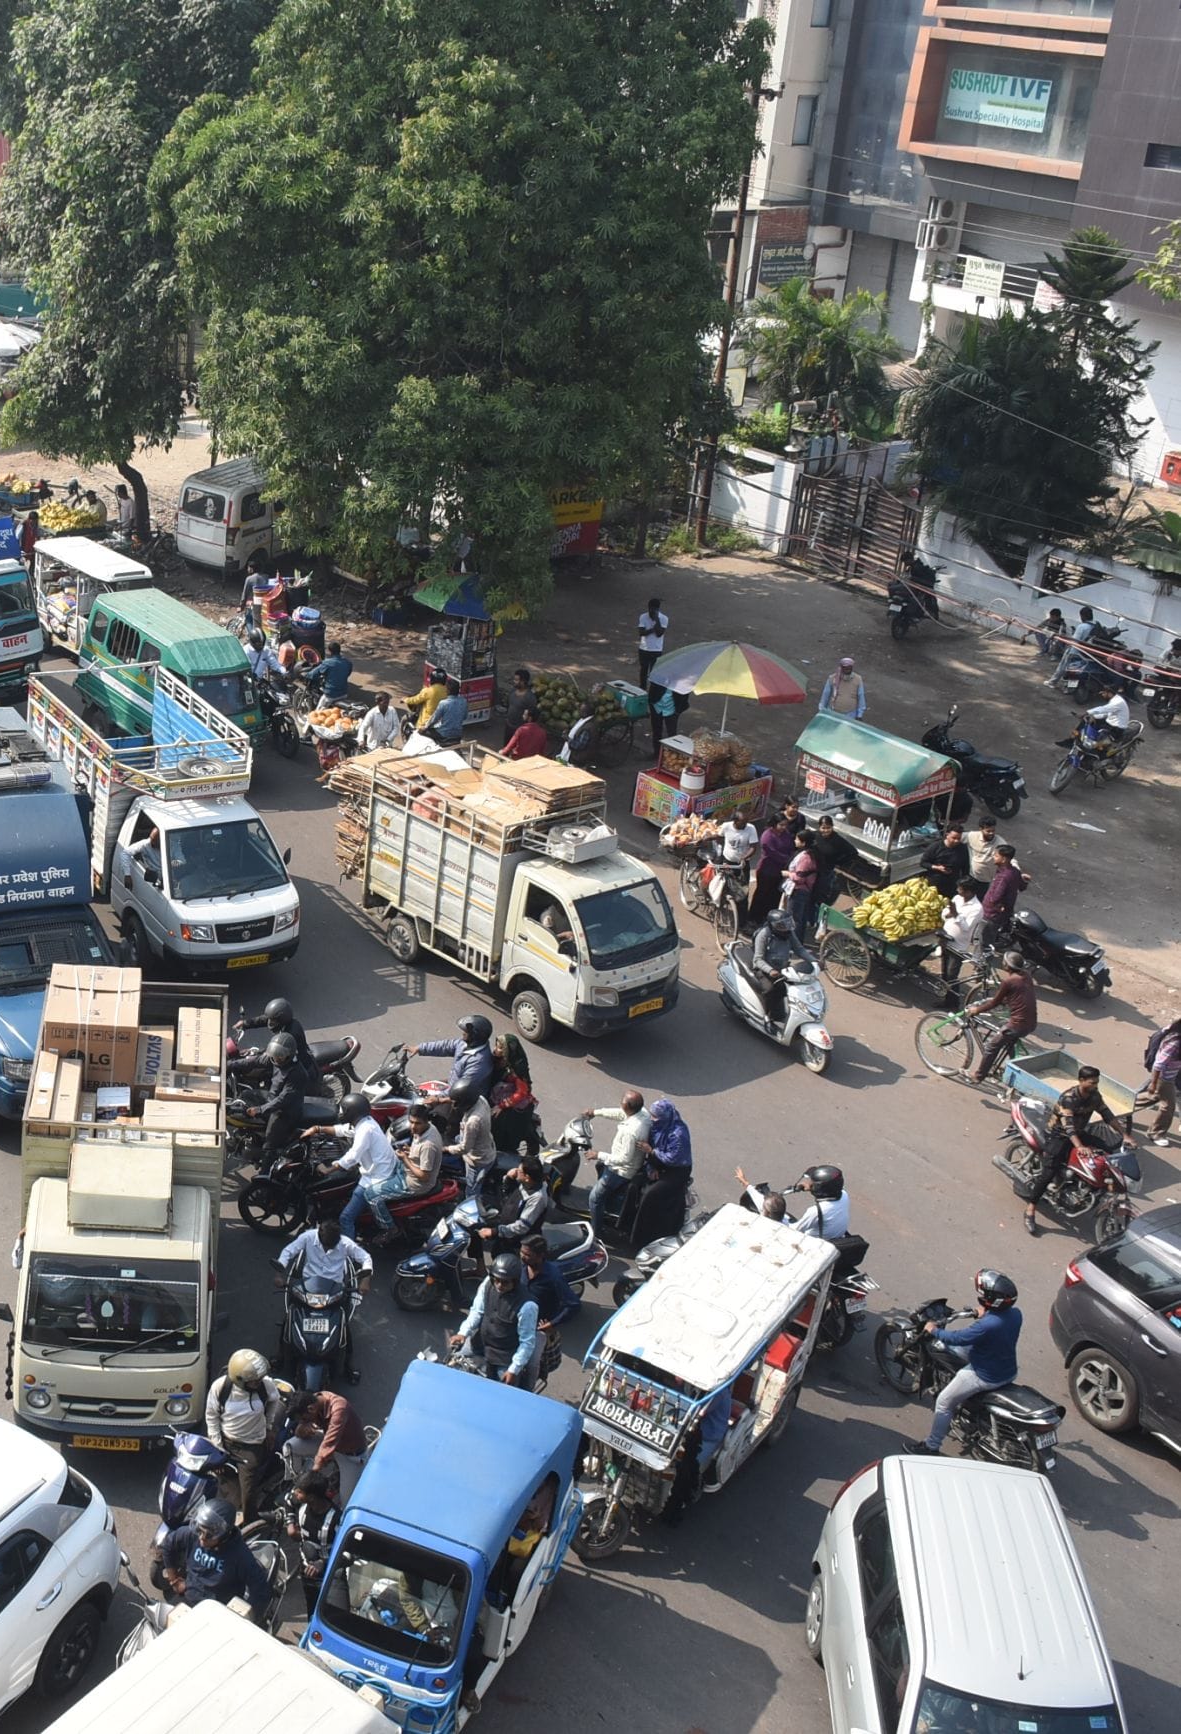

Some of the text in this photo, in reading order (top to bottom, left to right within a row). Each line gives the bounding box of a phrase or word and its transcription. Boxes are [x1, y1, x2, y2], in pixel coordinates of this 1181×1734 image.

[950, 70, 1051, 100] SUSHRUT IVF
[945, 106, 973, 119] Sushrut
[974, 110, 1011, 125] Speciality
[1011, 115, 1044, 129] Hospital
[1, 634, 28, 648] वाहन
[11, 870, 38, 884] प्रदेश
[40, 867, 70, 883] पुलिस
[7, 888, 45, 903] नियंत्रण
[47, 886, 75, 898] वाहन
[89, 1053, 110, 1065] LG
[145, 1035, 163, 1076] VOLTAS
[592, 1396, 671, 1446] MOHABBAT
[610, 1434, 633, 1450] yatri
[194, 1547, 224, 1573] CODE
